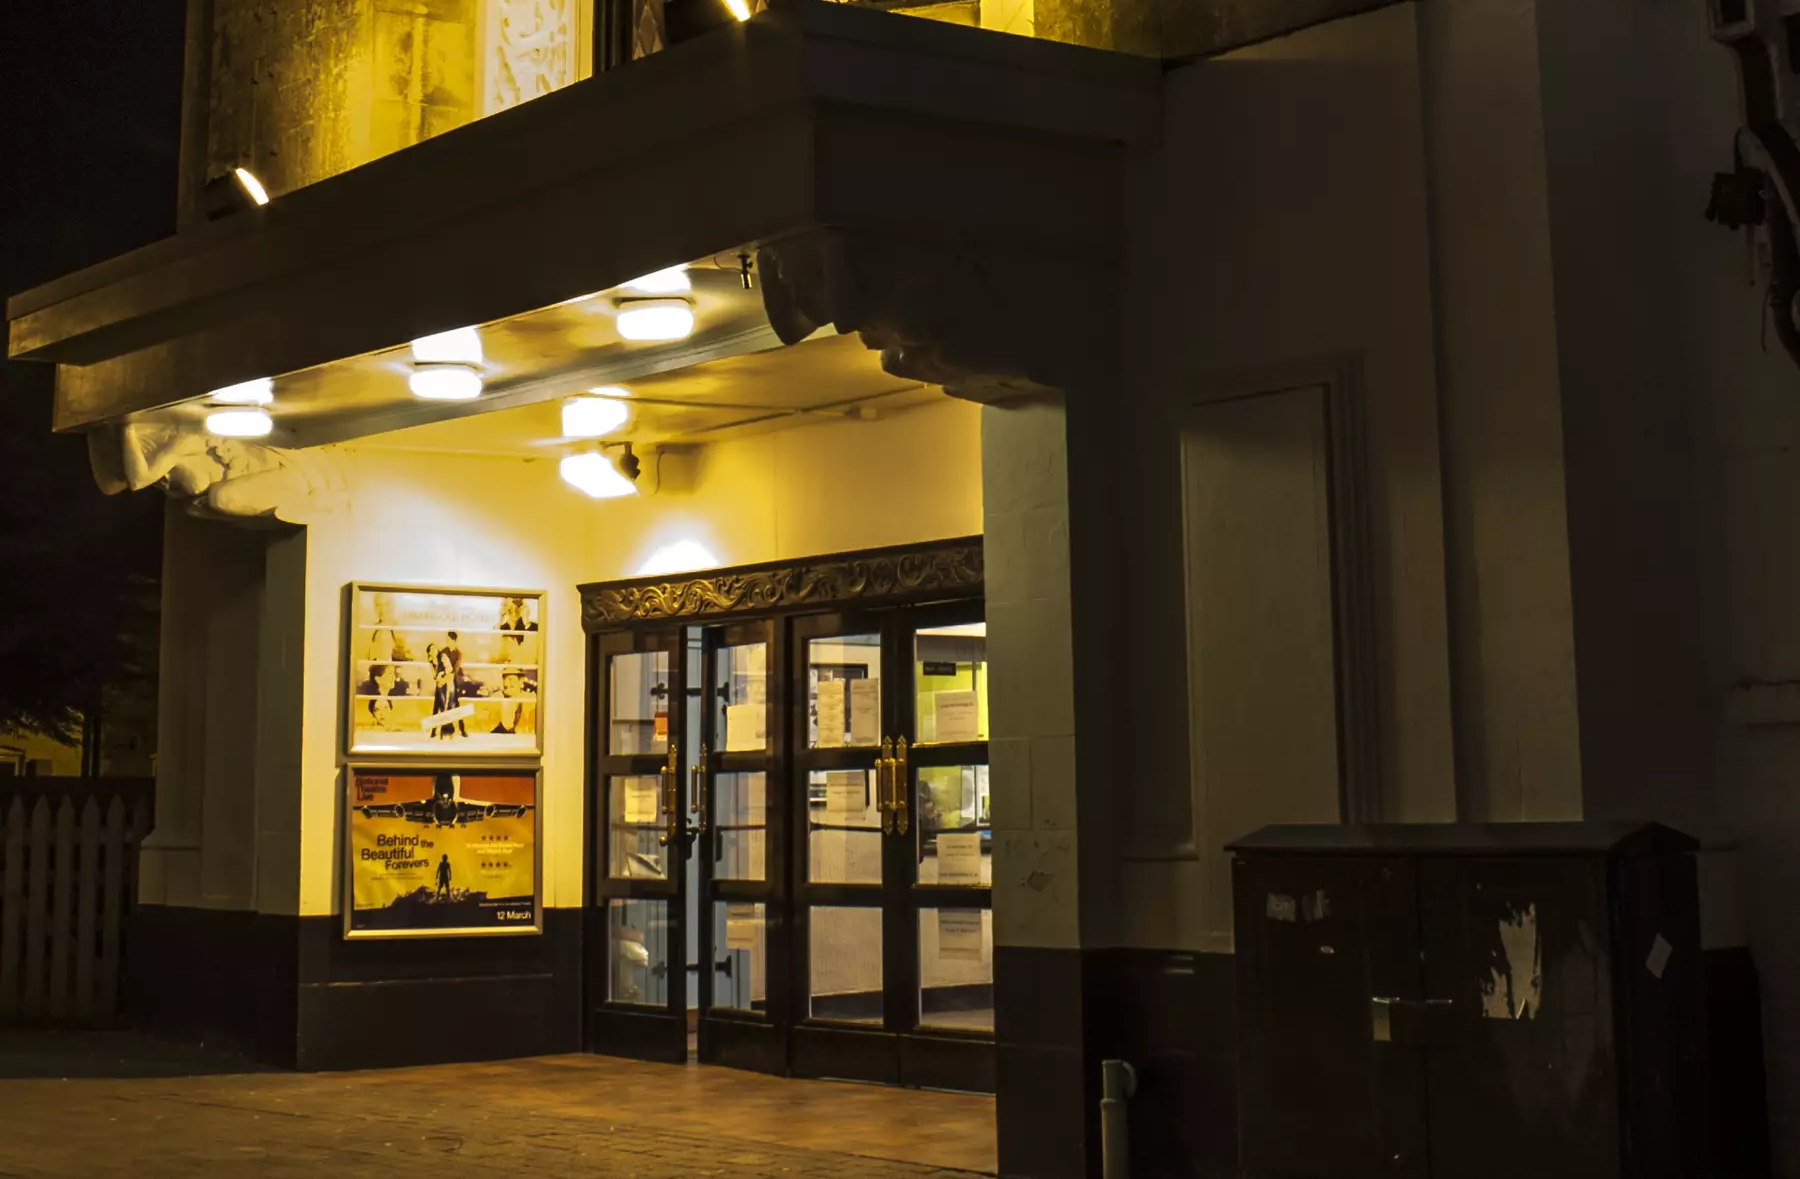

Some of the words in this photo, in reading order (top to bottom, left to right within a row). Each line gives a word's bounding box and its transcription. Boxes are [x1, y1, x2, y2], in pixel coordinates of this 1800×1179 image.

[377, 834, 419, 846] Behind
[420, 839, 434, 848] the
[361, 847, 414, 861] Beautiful
[385, 859, 429, 870] Forevers
[497, 911, 505, 920] 12
[507, 910, 531, 920] March
